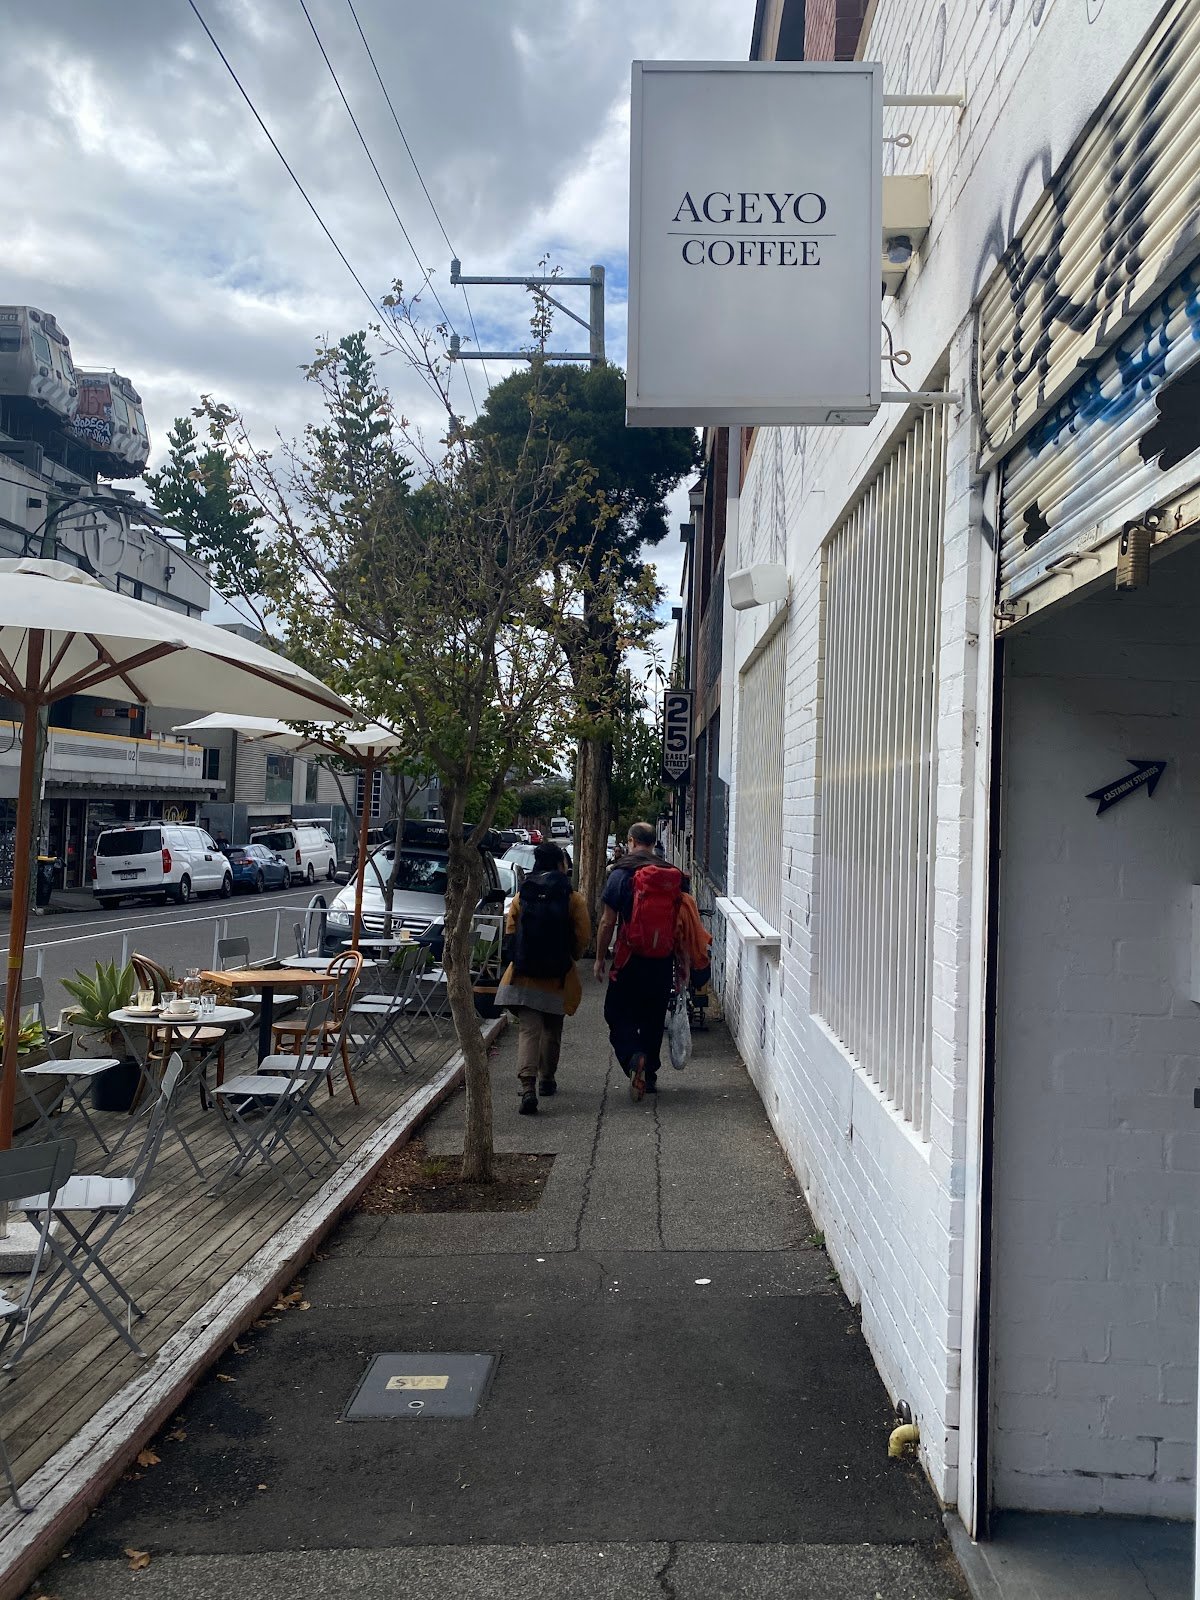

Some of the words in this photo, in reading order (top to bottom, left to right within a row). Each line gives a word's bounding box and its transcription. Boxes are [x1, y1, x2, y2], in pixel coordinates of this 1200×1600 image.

[672, 191, 827, 224] AGEYO
[682, 240, 821, 266] COFFEE
[73, 414, 112, 437] BODEGA
[1103, 779, 1134, 801] CASTAWAY
[1132, 765, 1159, 785] STUDIOS
